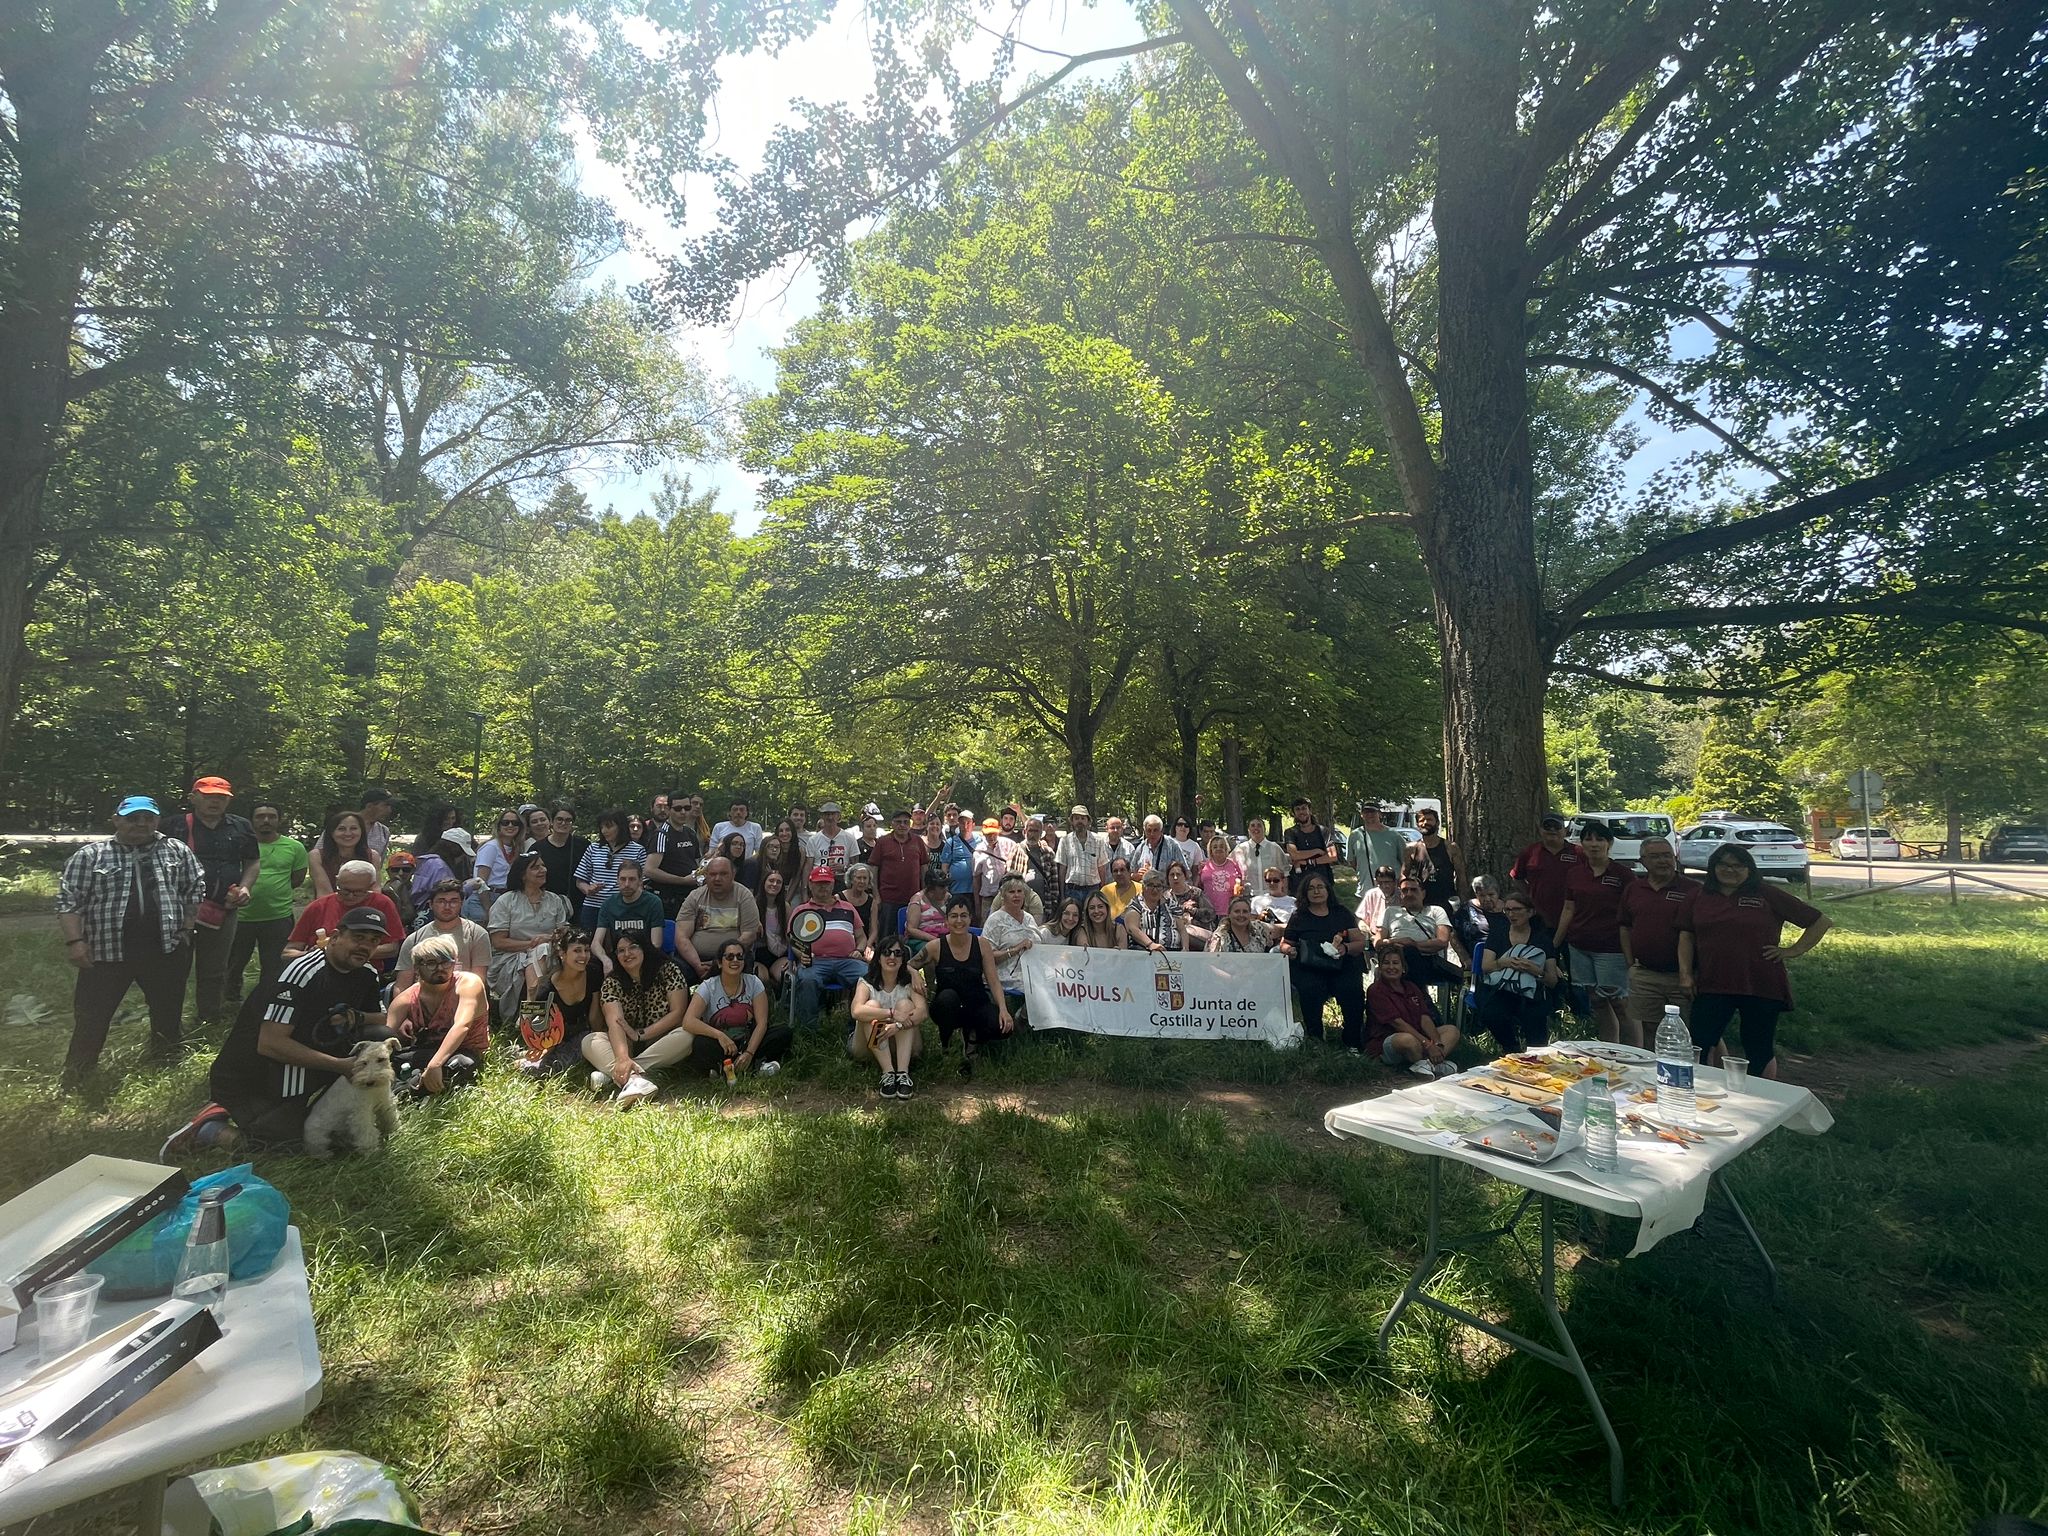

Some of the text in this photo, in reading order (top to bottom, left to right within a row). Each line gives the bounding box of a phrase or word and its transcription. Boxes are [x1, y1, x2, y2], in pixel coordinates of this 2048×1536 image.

[614, 919, 644, 930] PUMA
[1054, 968, 1085, 981] NOS
[1056, 982, 1136, 1003] IMPULSA
[1189, 997, 1257, 1011] Junta de
[1150, 1013, 1258, 1031] Castilla y León
